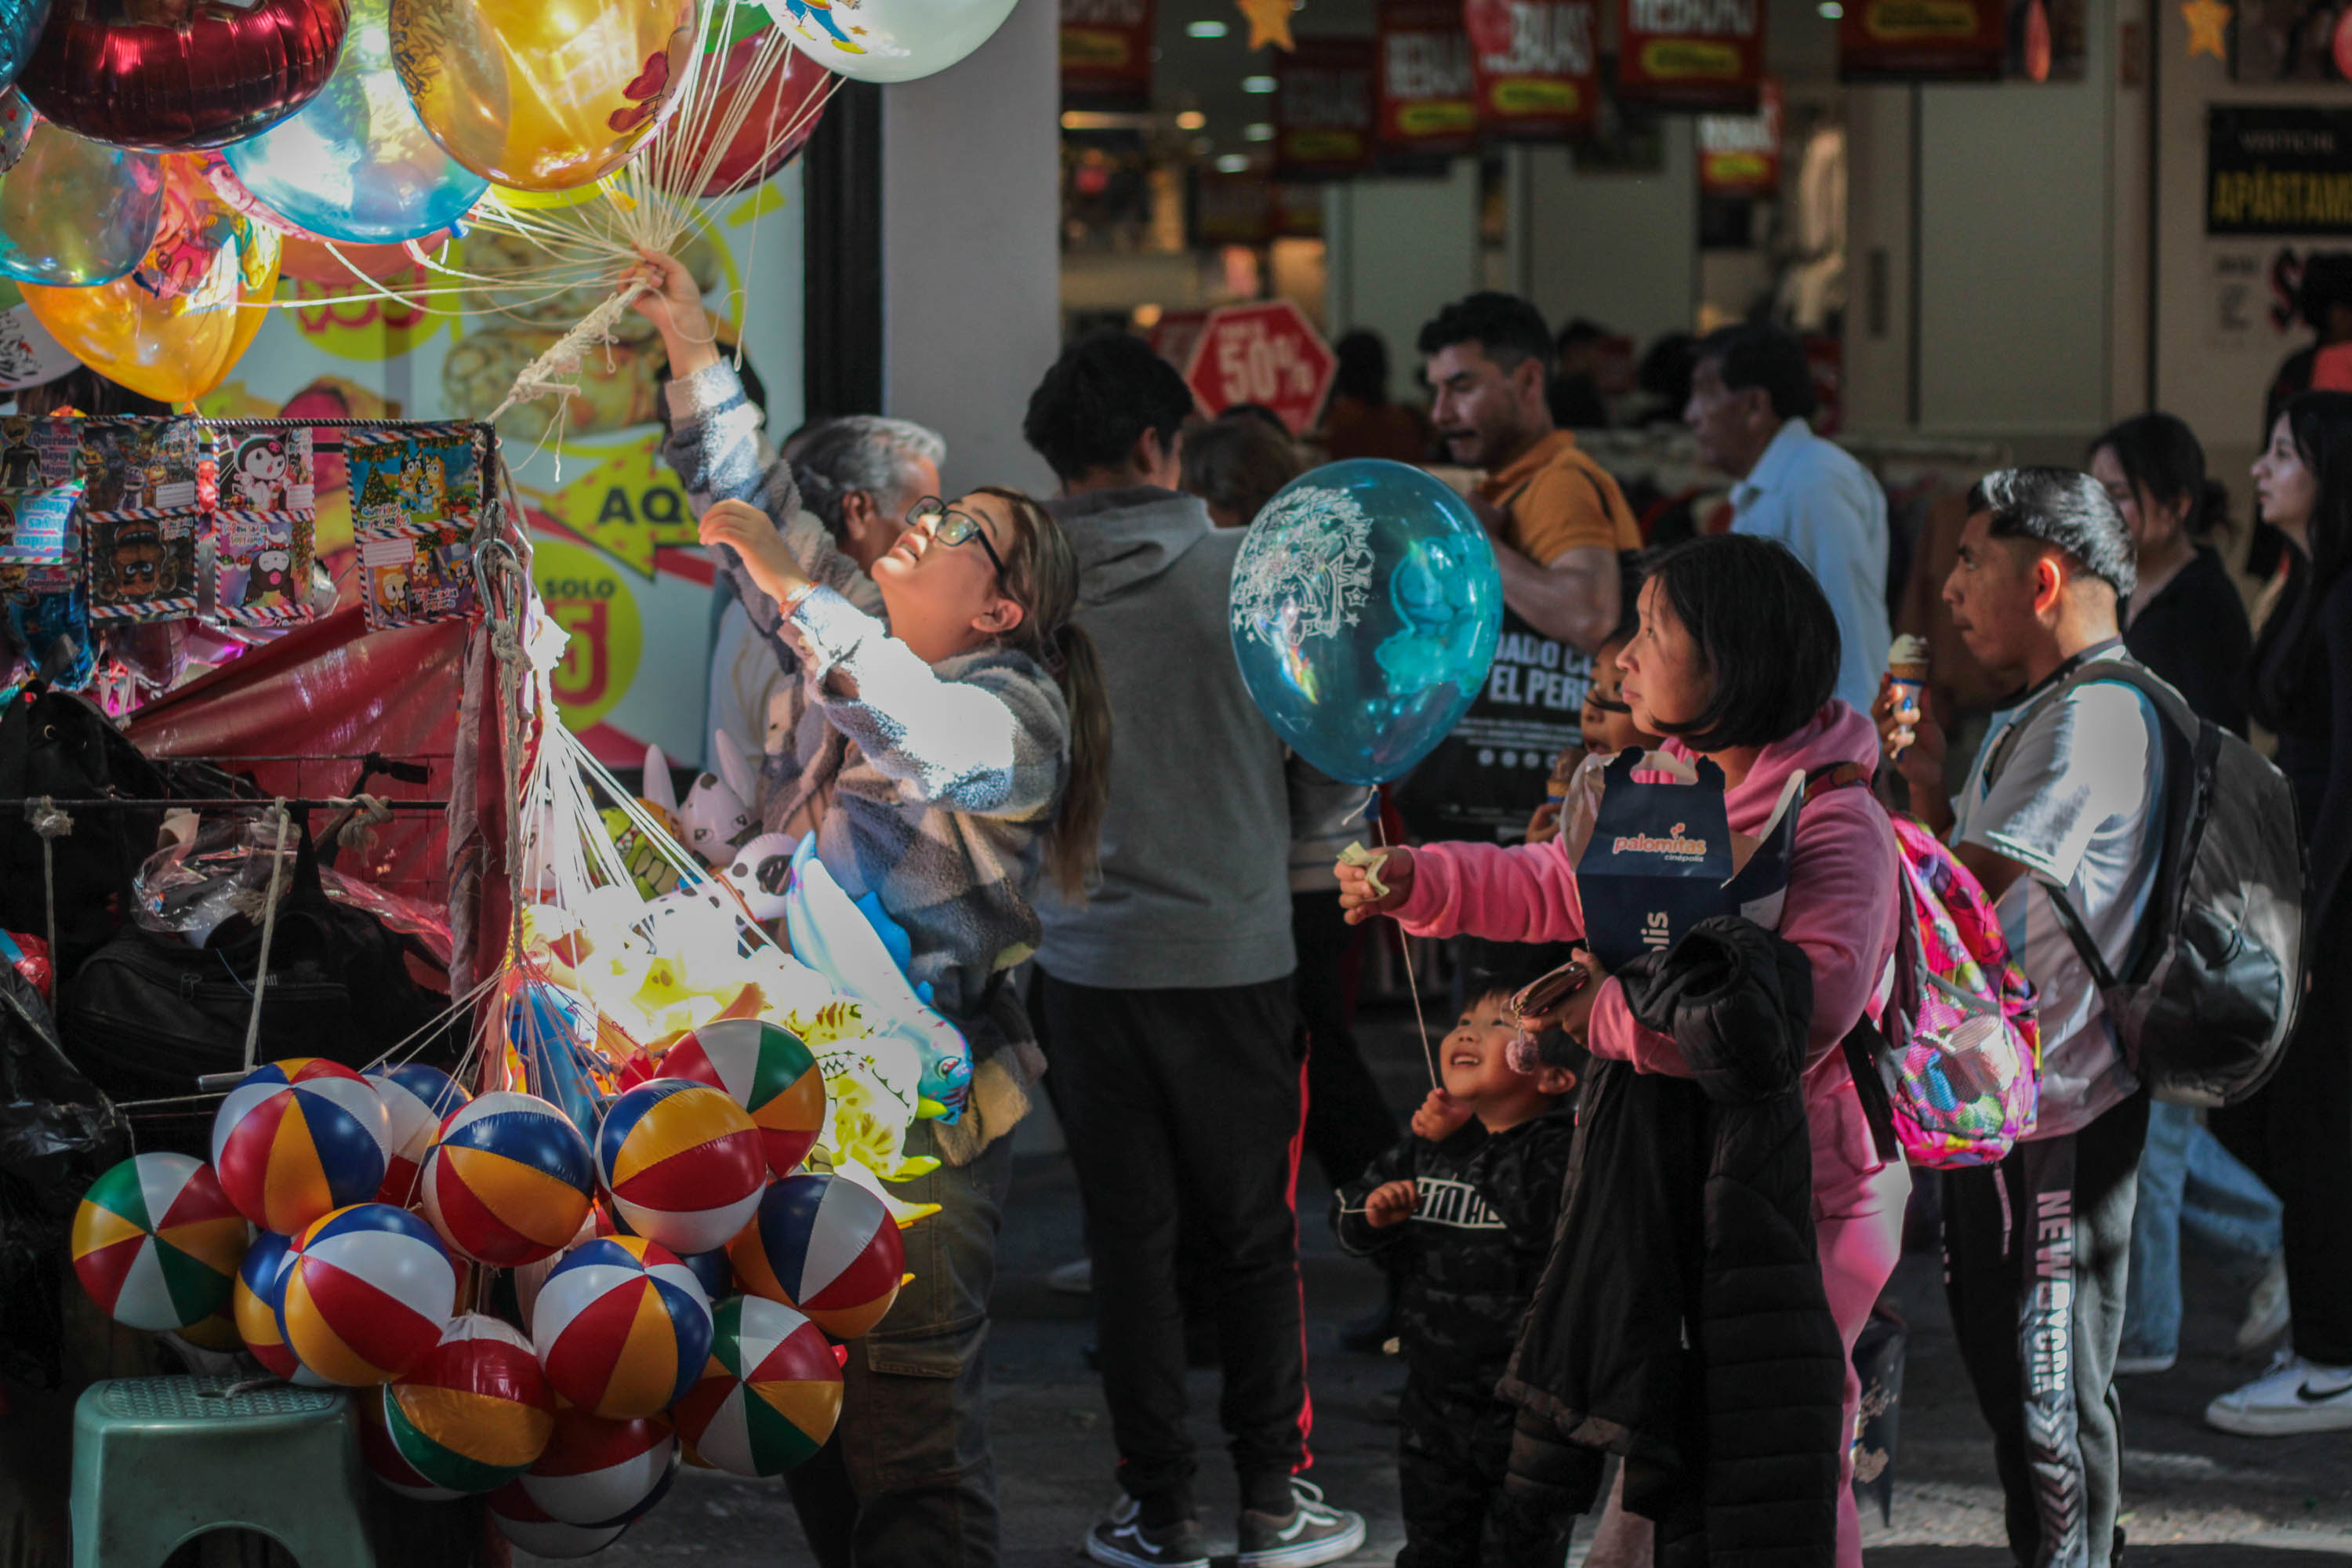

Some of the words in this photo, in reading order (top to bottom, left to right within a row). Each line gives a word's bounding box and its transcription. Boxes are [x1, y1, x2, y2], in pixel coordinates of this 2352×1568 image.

[1220, 335, 1316, 404] 50%
[597, 485, 684, 524] AQ
[544, 576, 615, 599] SOLO
[1490, 665, 1522, 702] EL
[1612, 827, 1707, 855] palomitas
[1640, 911, 1670, 953] lis
[2035, 1189, 2072, 1279] NEW
[2031, 1307, 2068, 1396] YORK
